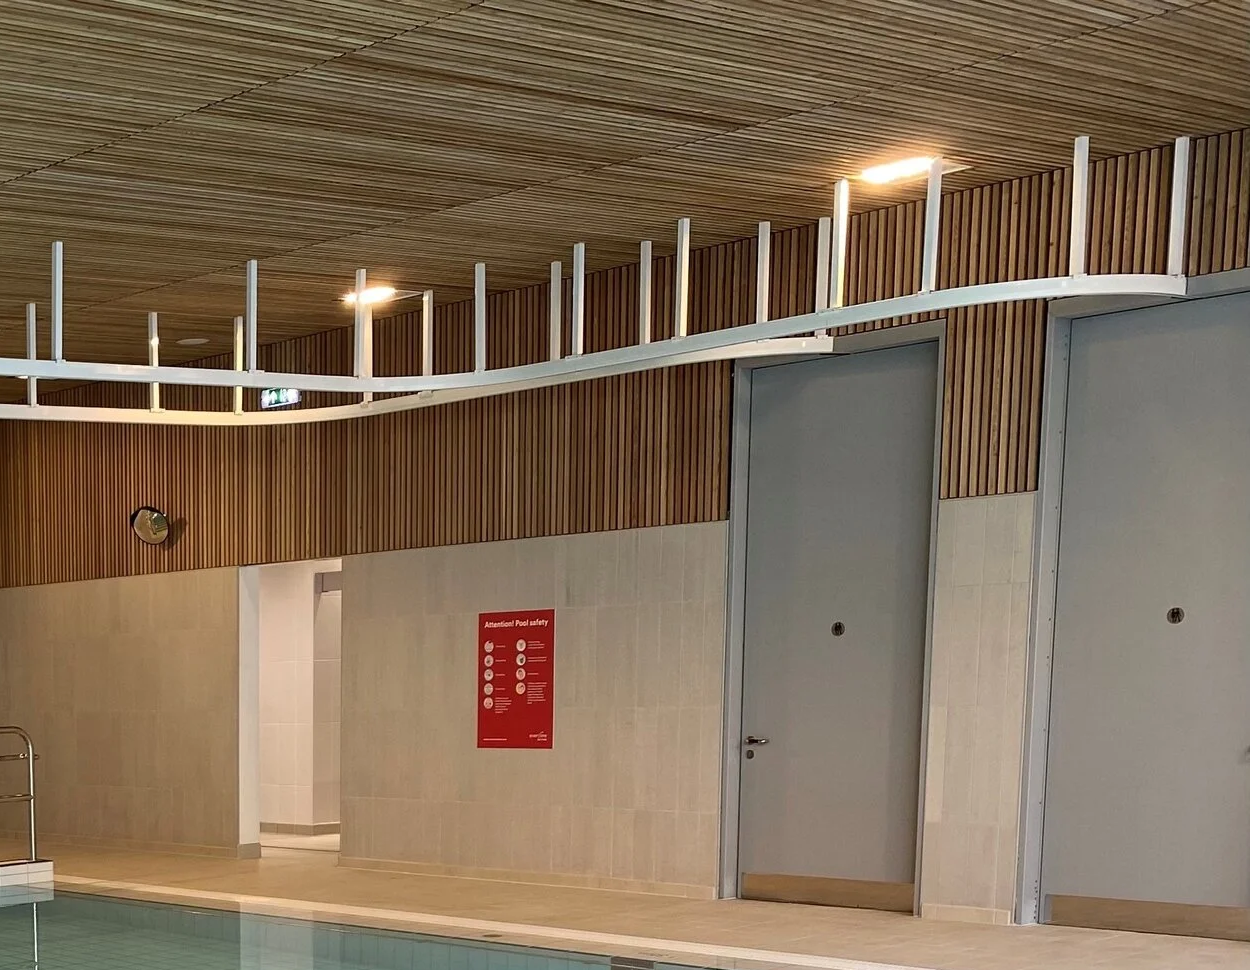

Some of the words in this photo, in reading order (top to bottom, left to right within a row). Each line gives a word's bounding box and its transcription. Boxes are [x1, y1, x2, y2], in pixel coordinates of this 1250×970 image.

[484, 620, 514, 628] Attention!
[515, 619, 528, 627] Pool
[530, 619, 548, 627] safety
